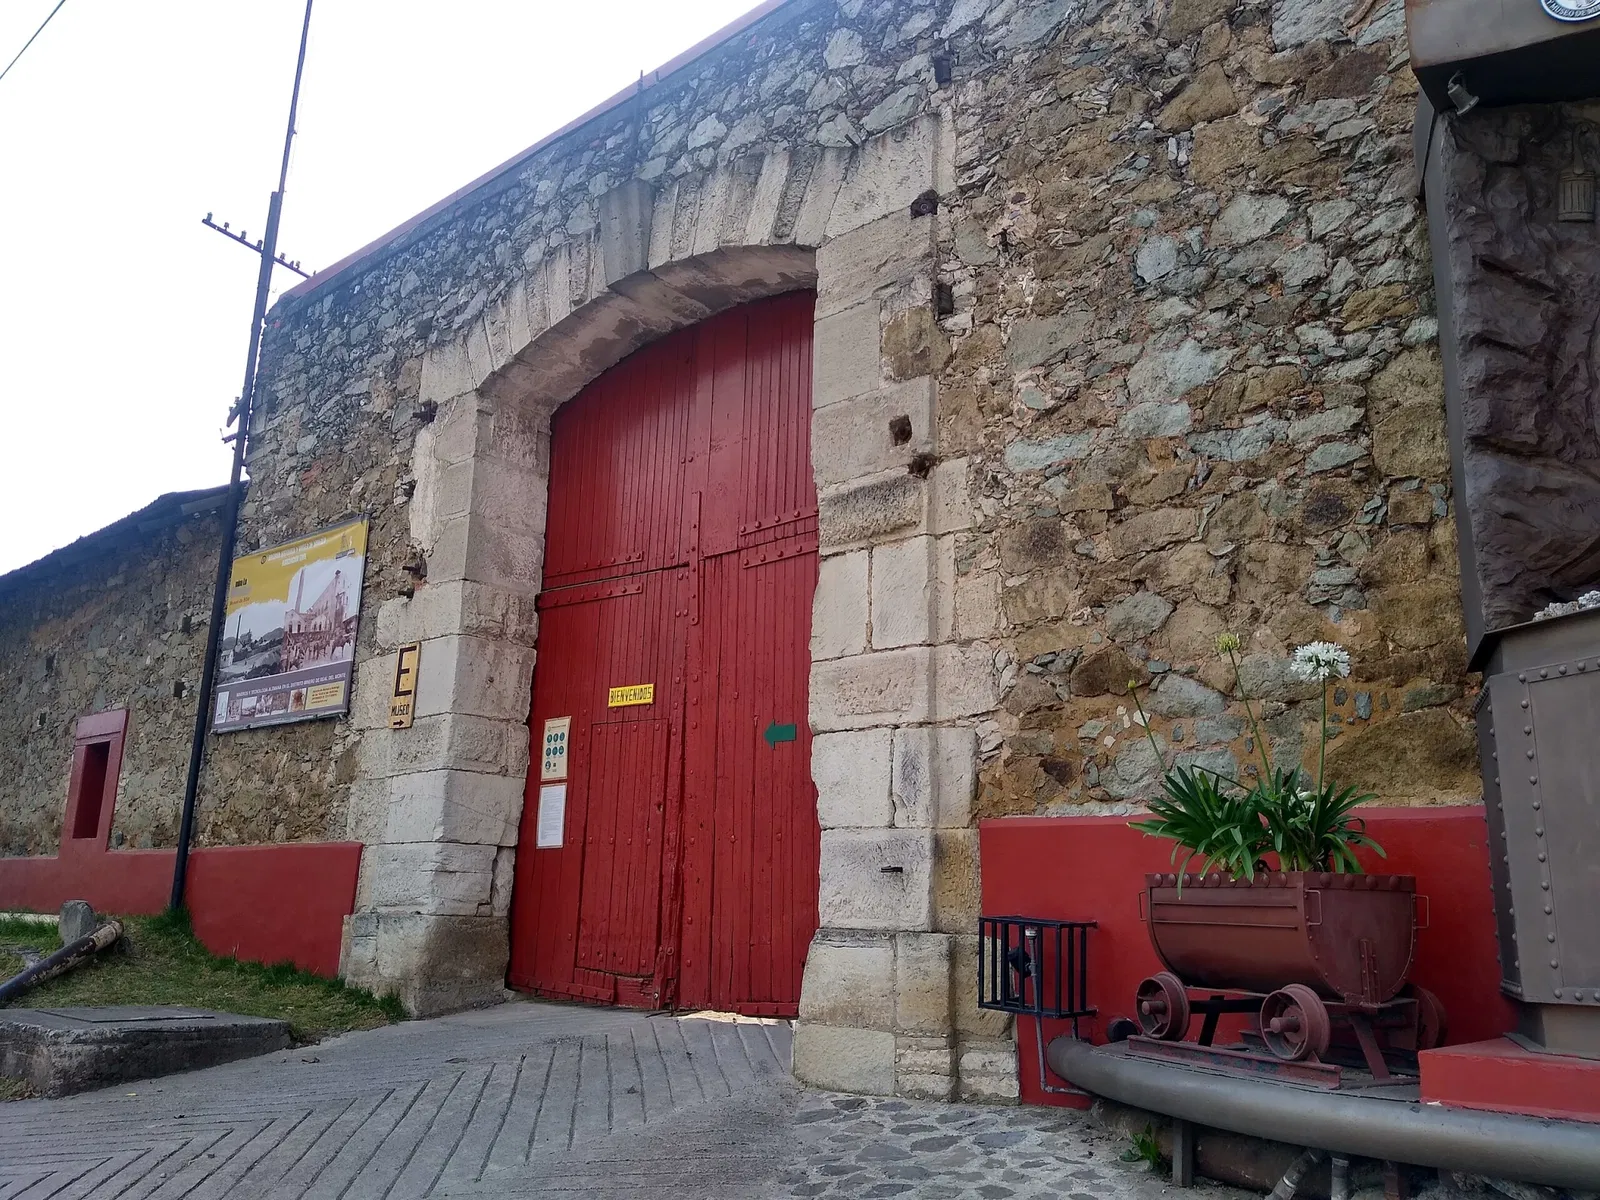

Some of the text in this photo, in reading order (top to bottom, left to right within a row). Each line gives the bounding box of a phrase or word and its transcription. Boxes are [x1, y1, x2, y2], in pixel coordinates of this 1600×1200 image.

[1550, 2, 1574, 17] MUSEO
[1575, 9, 1586, 17] DE
[394, 645, 417, 697] E
[610, 686, 652, 703] BIENVENIDOS
[390, 703, 410, 717] MUSEO
